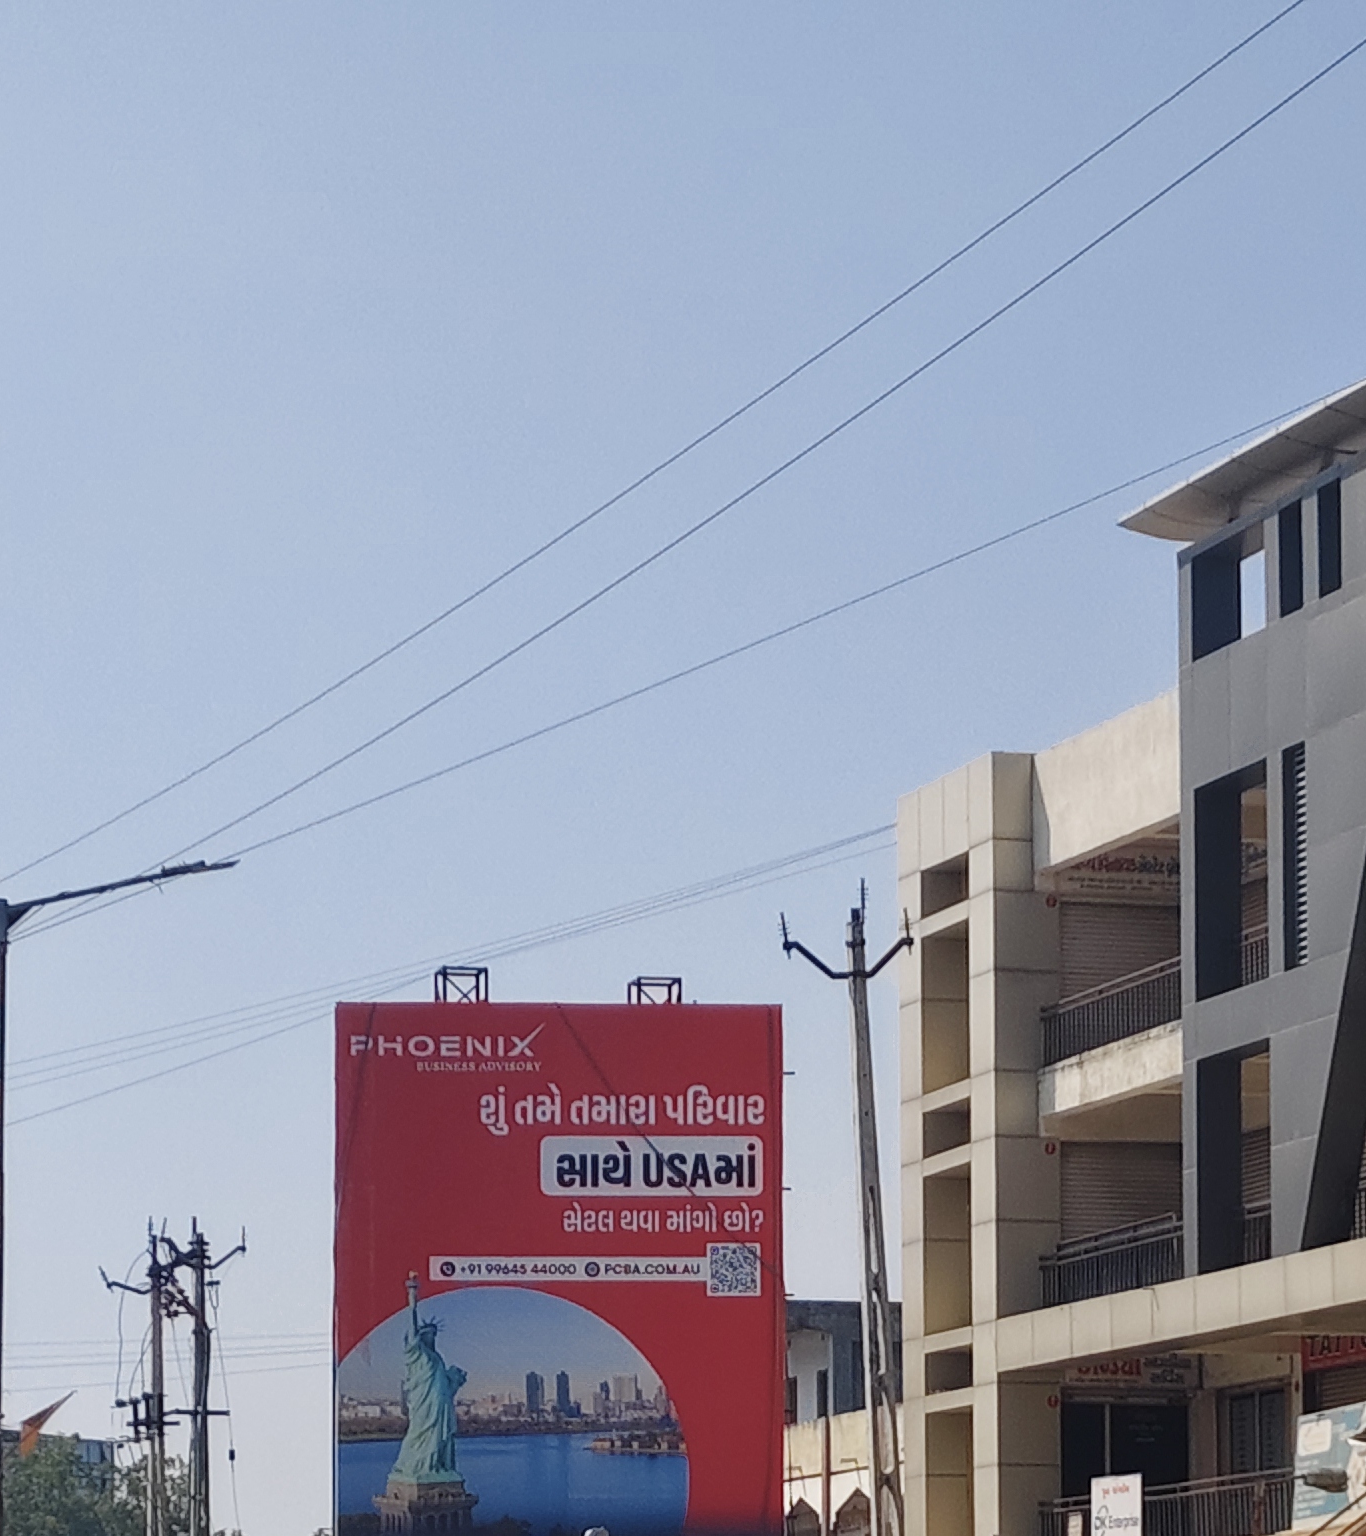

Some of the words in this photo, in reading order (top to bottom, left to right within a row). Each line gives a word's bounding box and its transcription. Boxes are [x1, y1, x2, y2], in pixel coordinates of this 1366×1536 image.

[350, 1023, 545, 1058] PHOENIX
[416, 1061, 476, 1072] BUSINESS
[479, 1061, 542, 1073] ADVISORY
[479, 1086, 511, 1136] શું
[514, 1082, 562, 1126] તમે
[569, 1093, 657, 1126] તમારા
[663, 1084, 766, 1126] પરિવાર
[556, 1140, 632, 1189] સાથે
[642, 1142, 757, 1189] USAમાં
[563, 1202, 614, 1233] સેટલ
[620, 1209, 661, 1233] થવા
[667, 1203, 718, 1233] માંગો
[723, 1203, 765, 1233] છો?
[484, 1263, 528, 1276] 99645
[531, 1263, 577, 1276] 44000
[603, 1263, 702, 1276] PCBA.COM.AU
